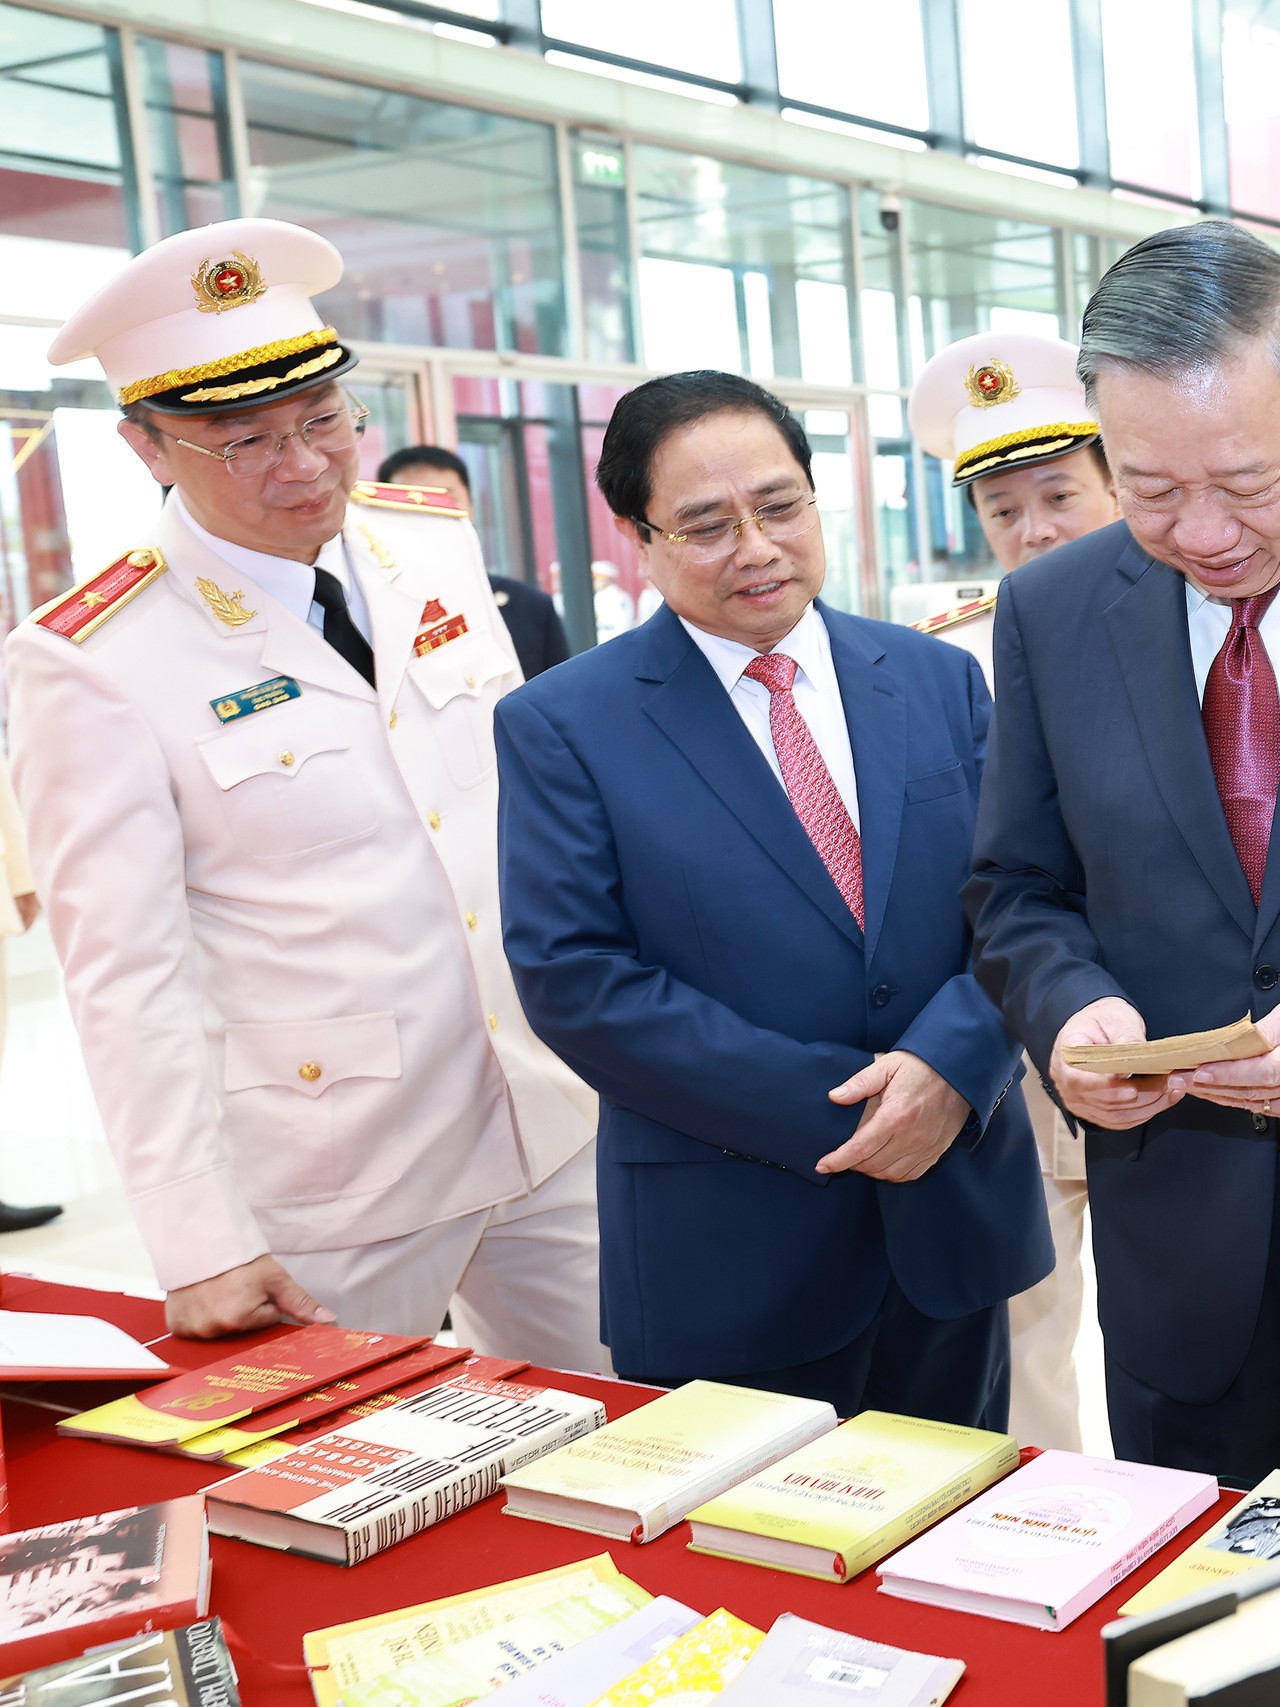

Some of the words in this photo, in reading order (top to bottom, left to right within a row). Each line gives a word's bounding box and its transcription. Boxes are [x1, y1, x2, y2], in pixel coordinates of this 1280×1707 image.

[389, 1387, 574, 1437] DECEPTION
[293, 1446, 389, 1471] MOSSAD
[317, 1436, 412, 1460] OFFICER
[442, 1434, 519, 1464] OF
[511, 1447, 539, 1468] VICTOR
[284, 1459, 310, 1468] OF
[360, 1456, 462, 1493] WAY
[273, 1471, 322, 1484] MAKING
[313, 1480, 343, 1490] THE
[319, 1489, 402, 1523] BY
[349, 1524, 372, 1565] BY
[374, 1506, 407, 1551] WAY
[410, 1494, 430, 1532] OF
[433, 1456, 505, 1522] DECEPTION
[1072, 1527, 1098, 1537] LỊCH
[186, 1621, 219, 1675] TRENTO
